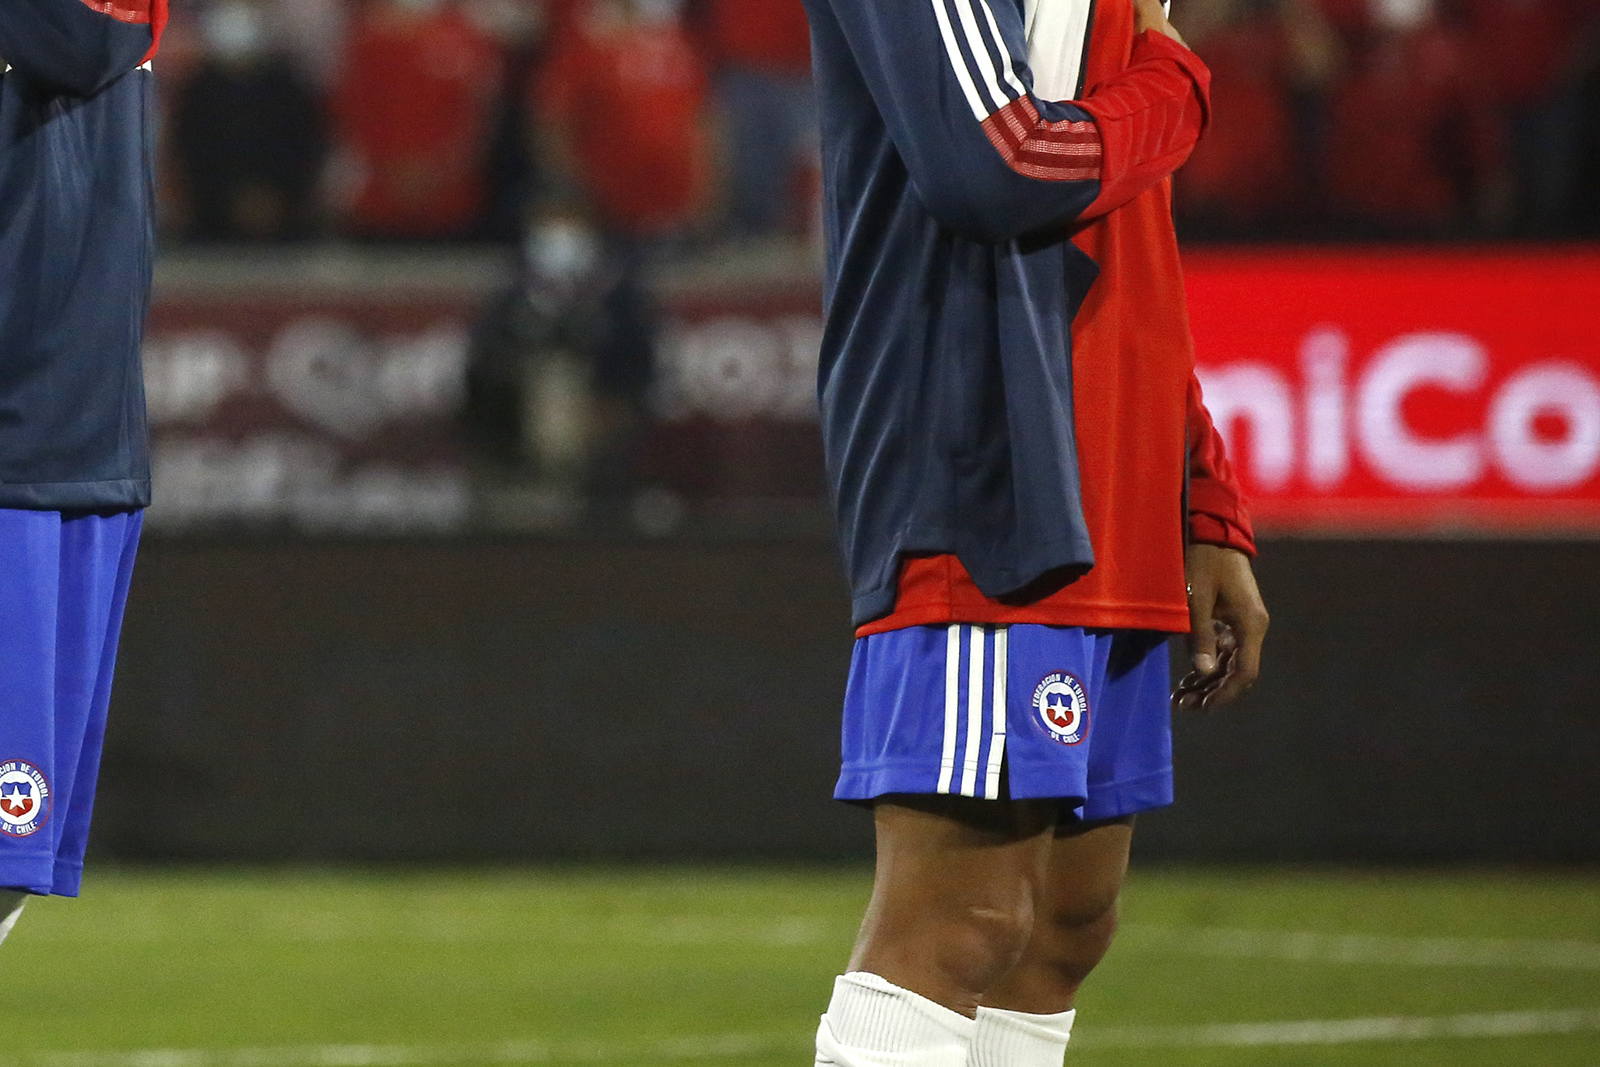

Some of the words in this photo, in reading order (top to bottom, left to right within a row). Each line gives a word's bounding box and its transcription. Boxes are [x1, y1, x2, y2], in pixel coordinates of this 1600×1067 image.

[1064, 675, 1074, 686] DE
[20, 762, 31, 773] DE
[31, 769, 49, 799] FUTBOL
[2, 821, 13, 833] DE
[16, 821, 37, 834] CHILE
